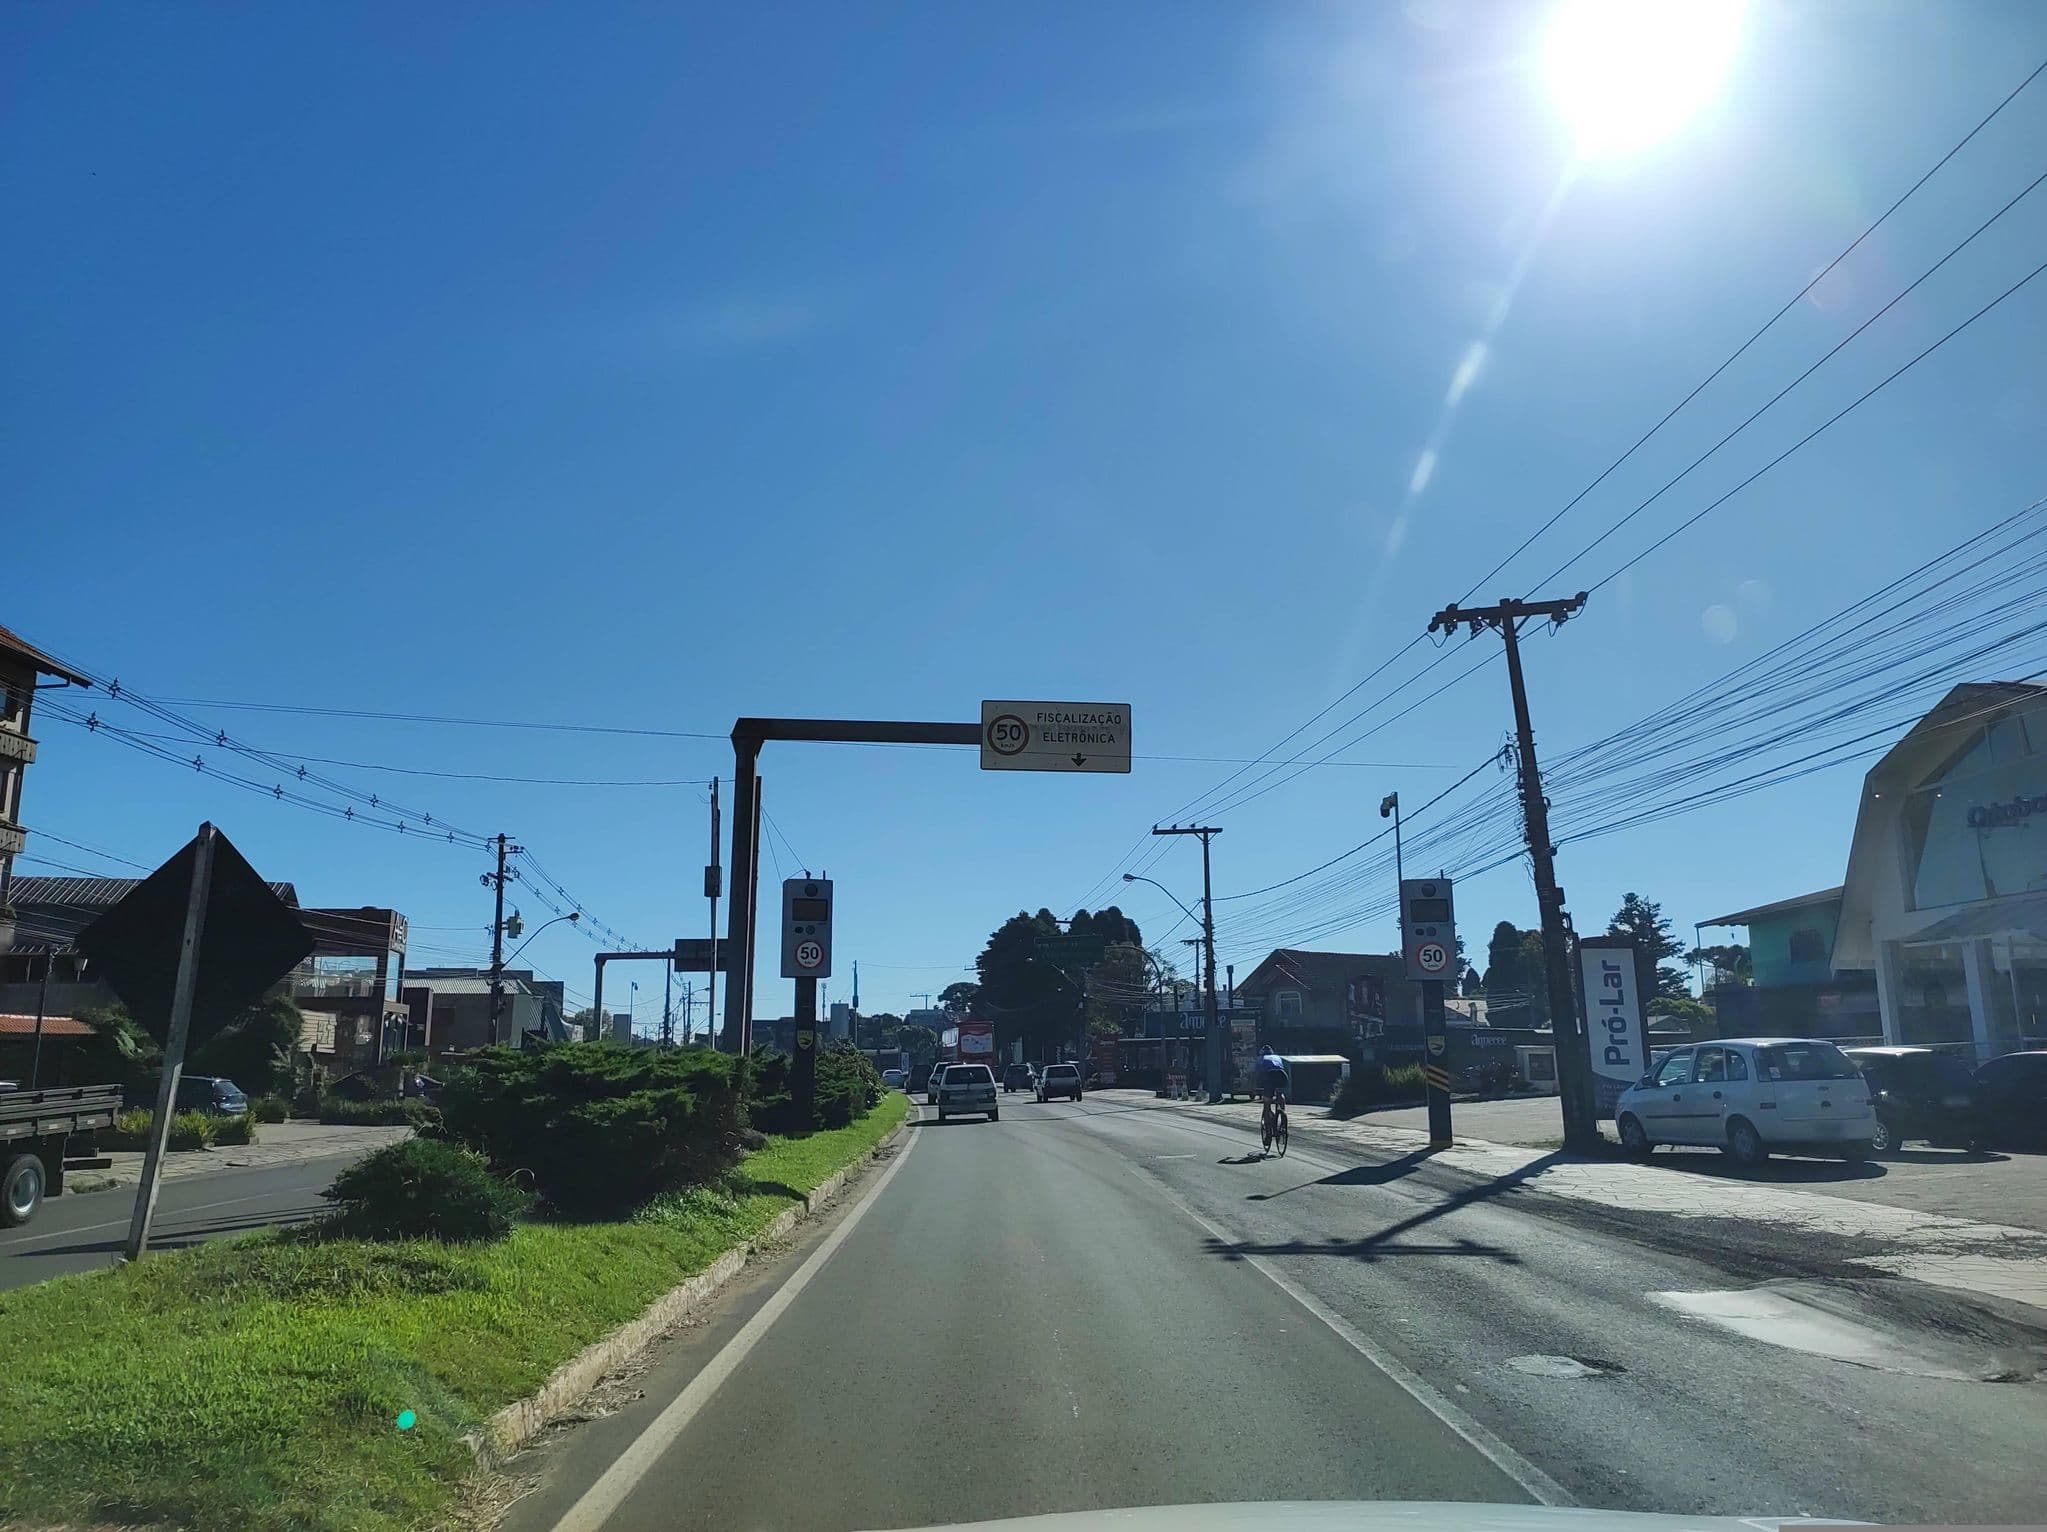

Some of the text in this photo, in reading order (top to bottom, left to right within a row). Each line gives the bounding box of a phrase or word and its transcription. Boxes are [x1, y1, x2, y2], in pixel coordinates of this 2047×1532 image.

[1036, 711, 1122, 726] FISCALIZAÇÃO
[996, 724, 1022, 741] 50
[1043, 729, 1116, 744] ELETRÔNICA
[799, 946, 819, 960] 50
[1422, 949, 1443, 963] 50
[1599, 959, 1630, 1066] Pró-Lar
